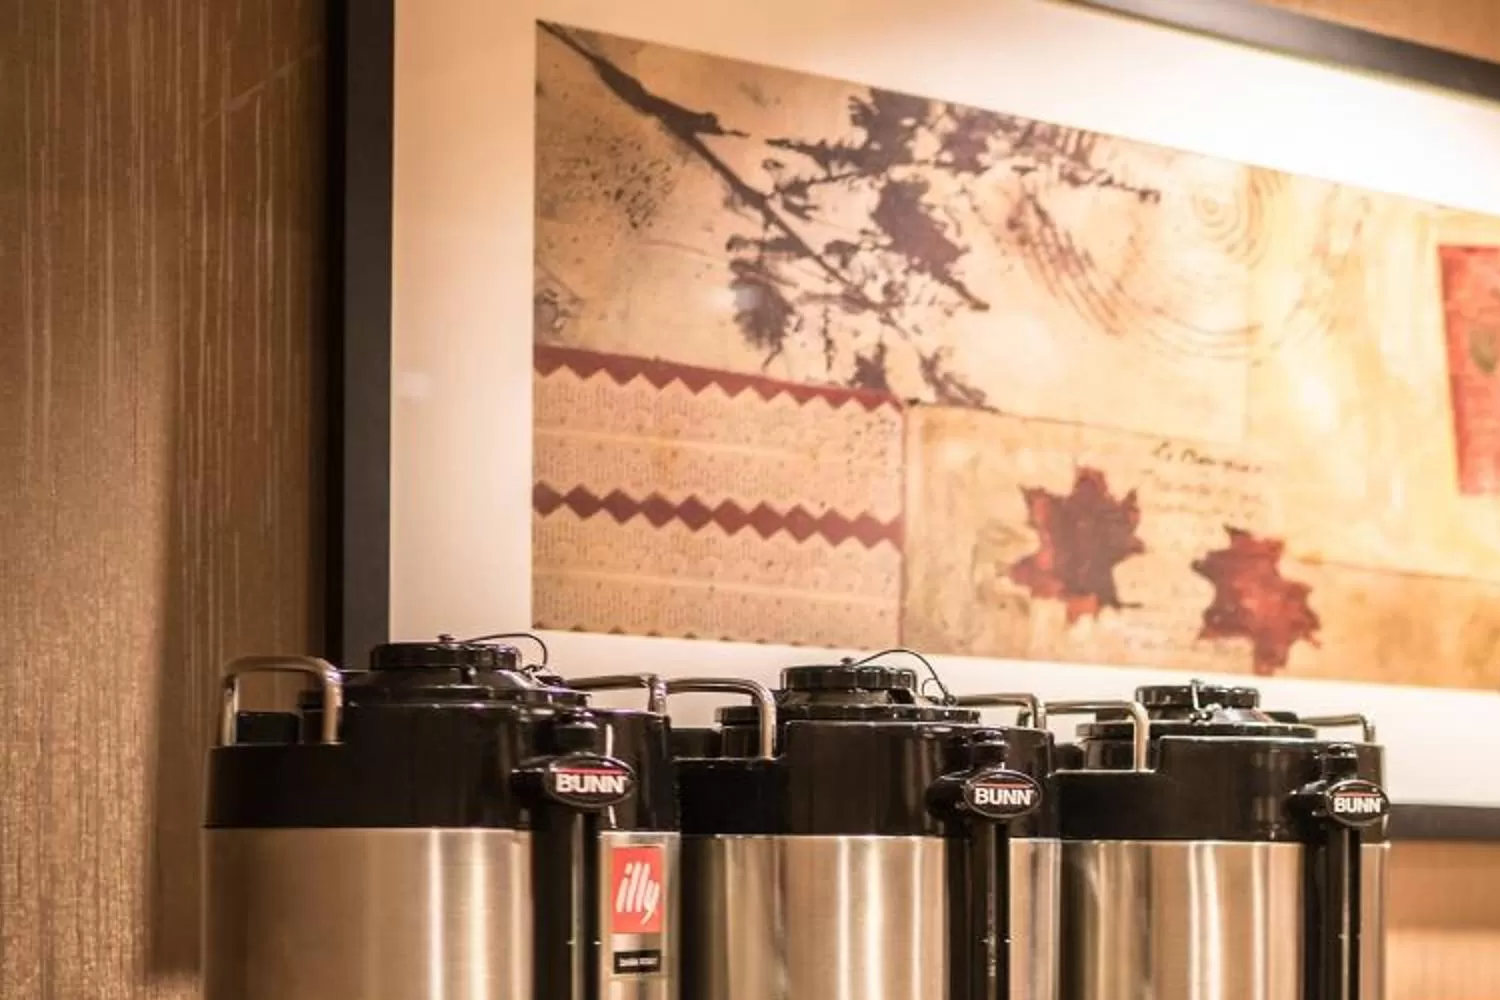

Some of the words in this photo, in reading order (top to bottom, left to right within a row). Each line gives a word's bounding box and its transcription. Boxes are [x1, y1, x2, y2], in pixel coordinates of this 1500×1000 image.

[556, 773, 626, 794] BUNN
[974, 788, 1033, 805] BUNN
[1333, 797, 1382, 813] BUNN
[615, 861, 661, 926] illy
